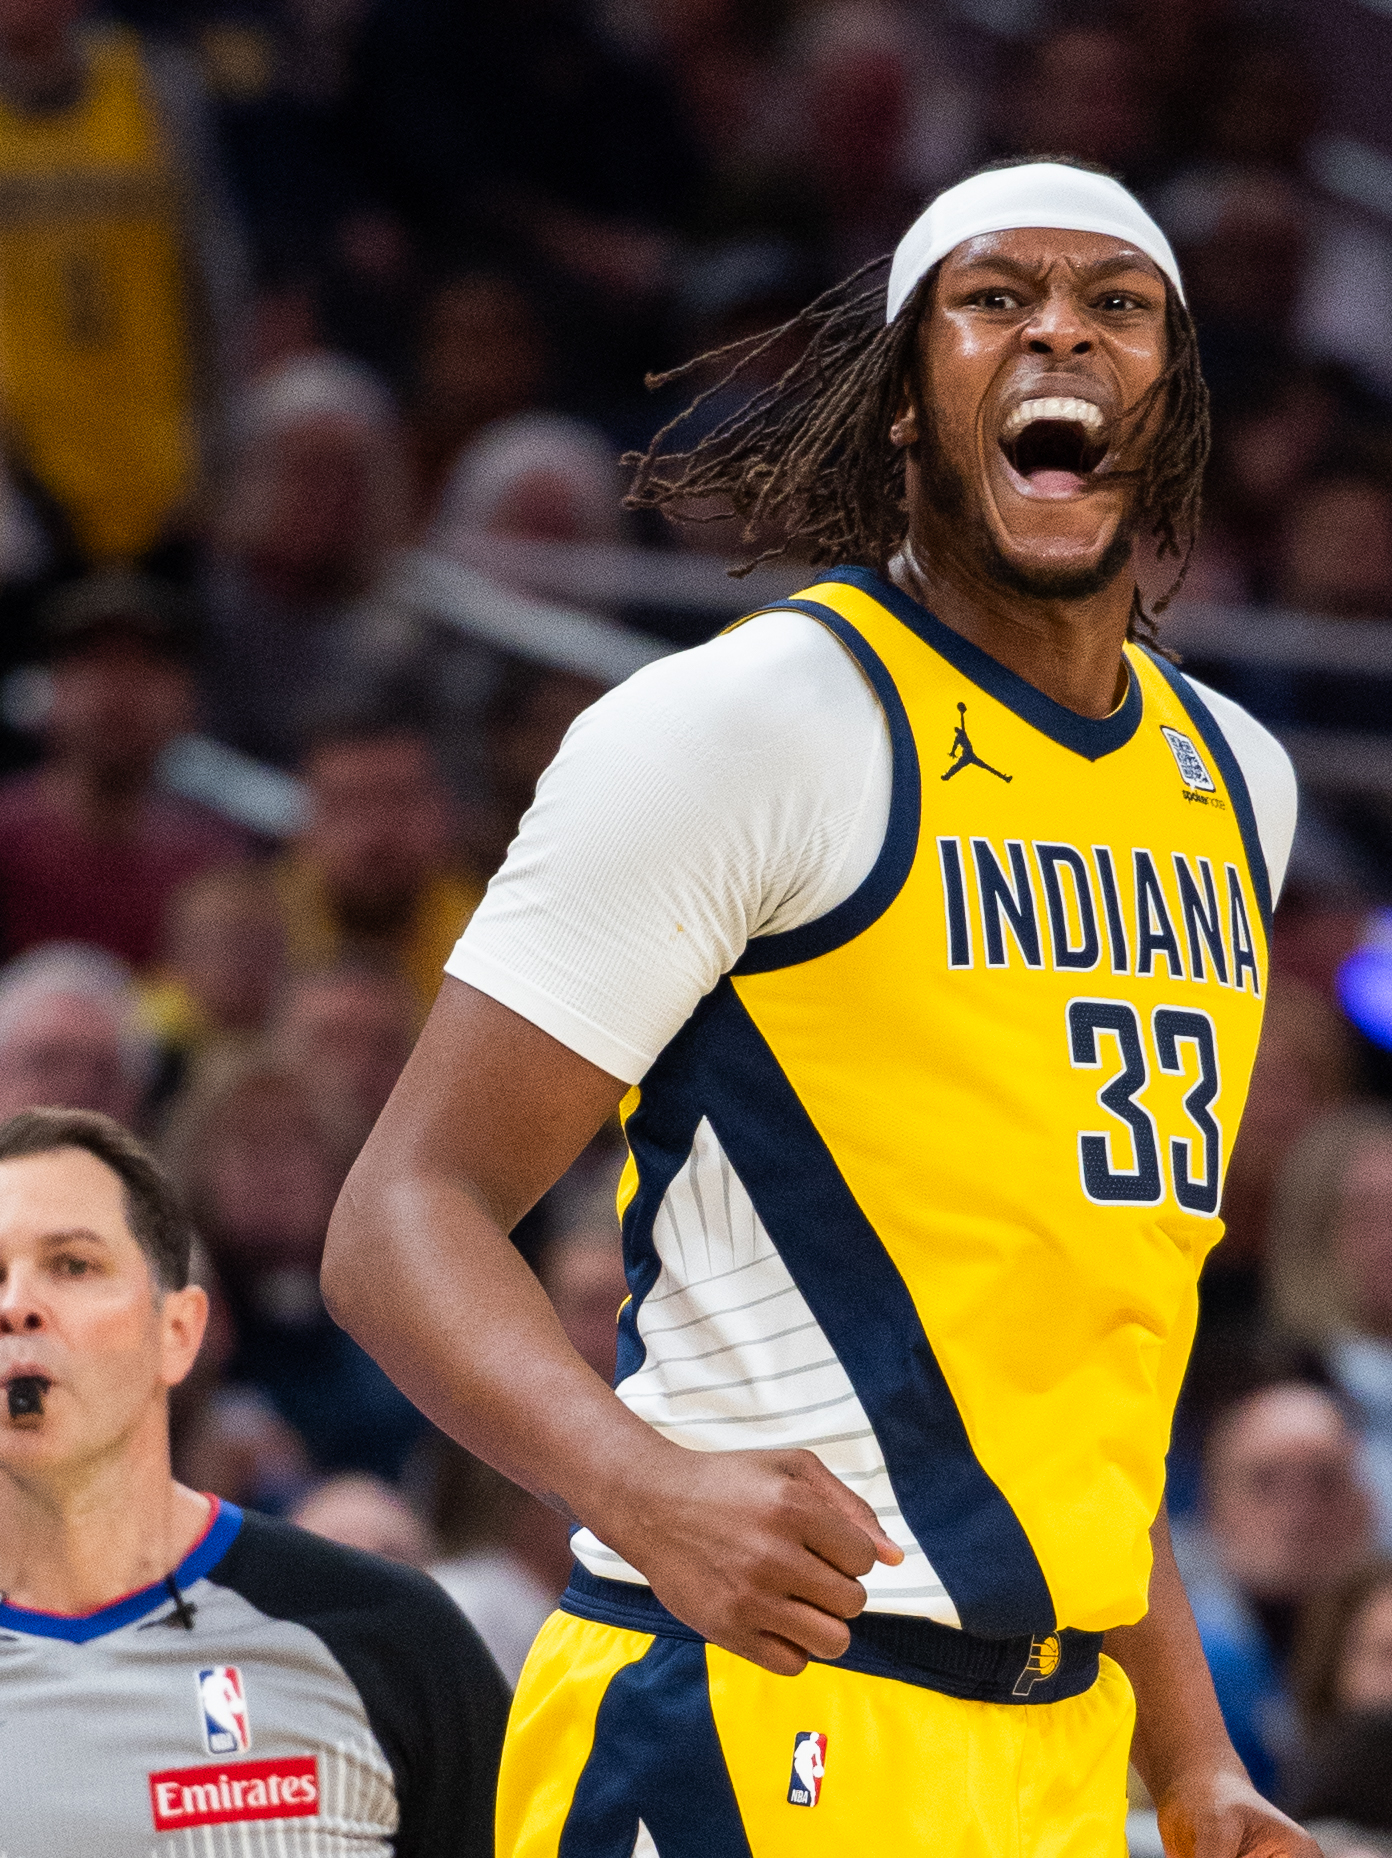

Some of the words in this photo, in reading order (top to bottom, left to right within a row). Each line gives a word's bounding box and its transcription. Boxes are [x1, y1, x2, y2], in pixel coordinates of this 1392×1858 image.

[1182, 790, 1225, 811] spokeote
[936, 836, 1262, 1000] INDIANA
[1065, 997, 1223, 1218] 33
[155, 1774, 317, 1818] Emirates
[790, 1789, 809, 1804] NBA
